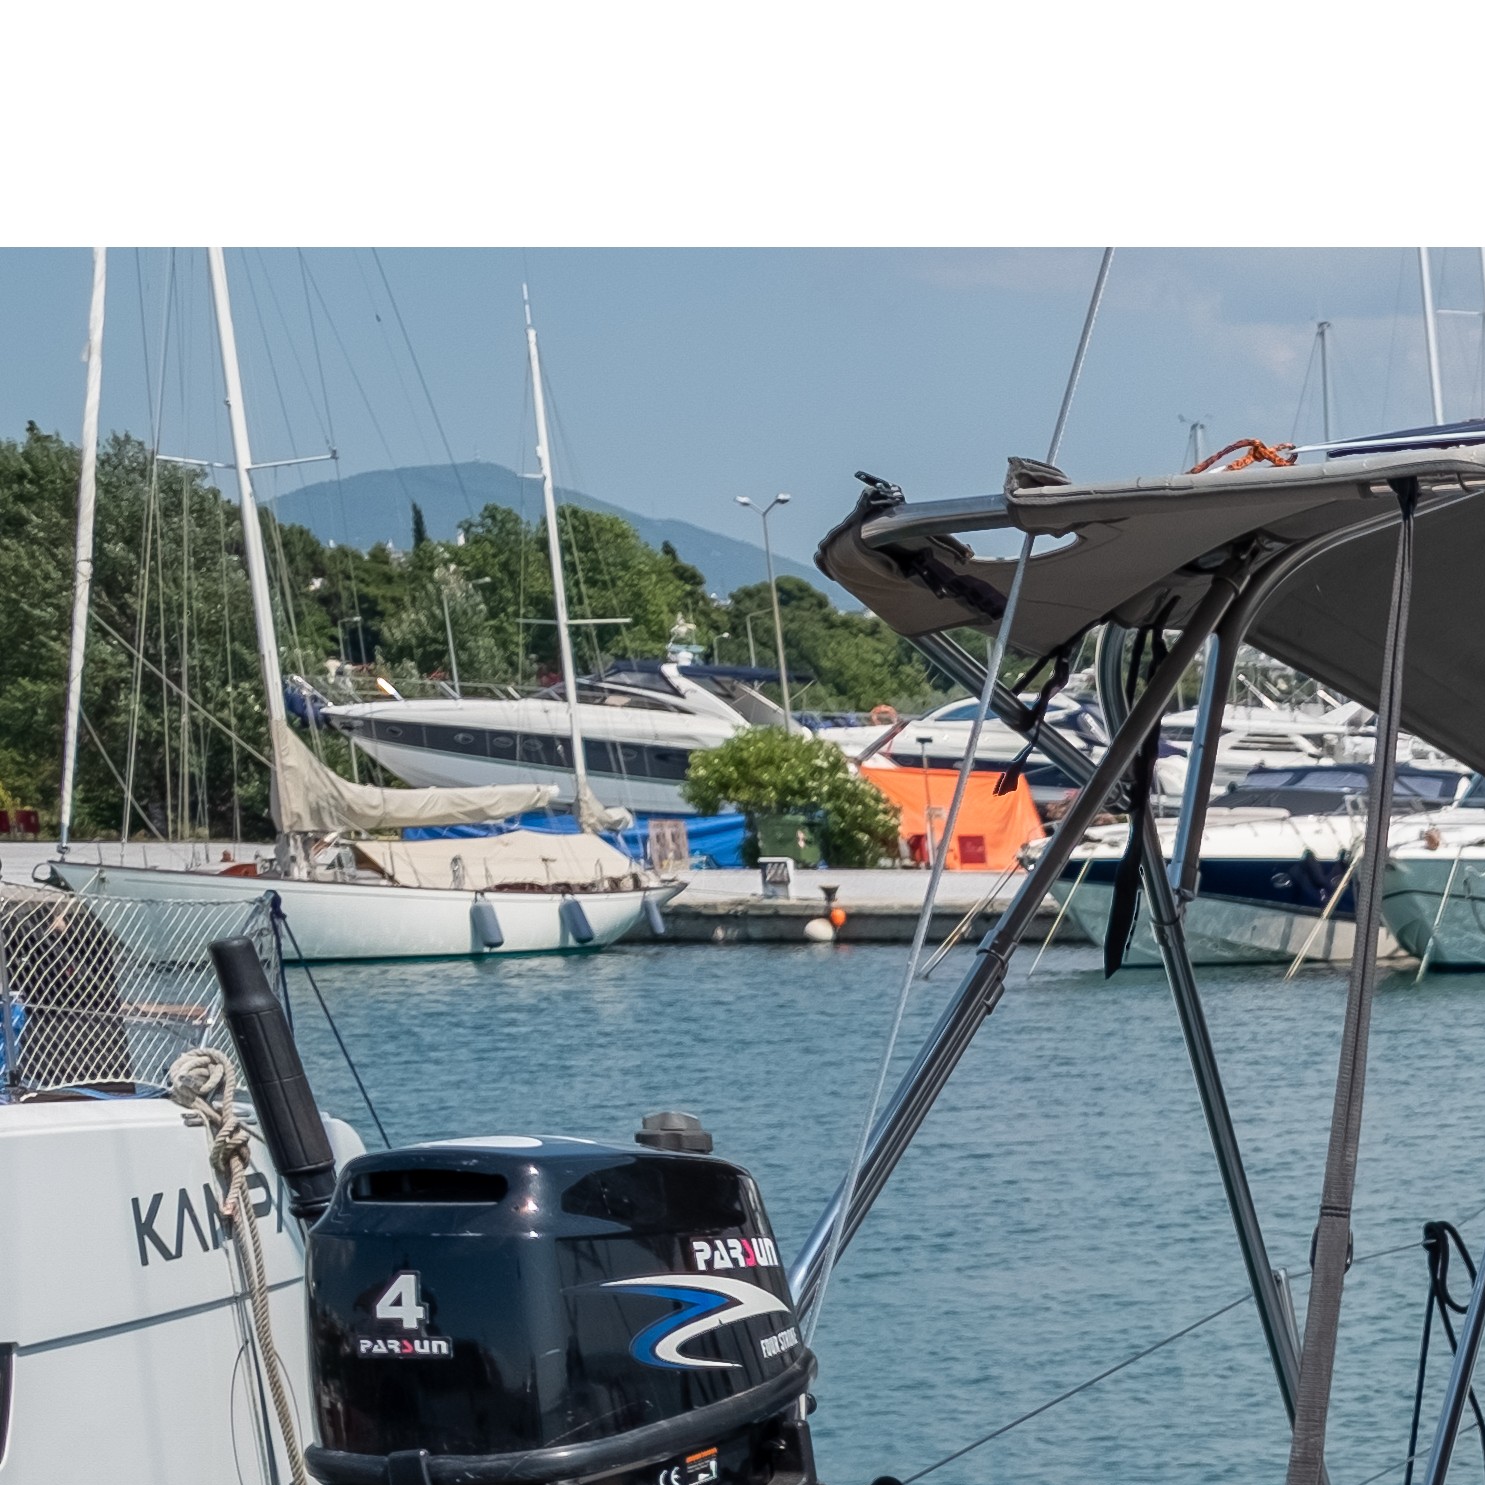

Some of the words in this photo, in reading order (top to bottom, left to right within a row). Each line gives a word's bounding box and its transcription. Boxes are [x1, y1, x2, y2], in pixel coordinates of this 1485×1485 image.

[692, 1237, 779, 1271] PARSUN
[375, 1274, 425, 1330] 4
[359, 1339, 450, 1355] PARSUN
